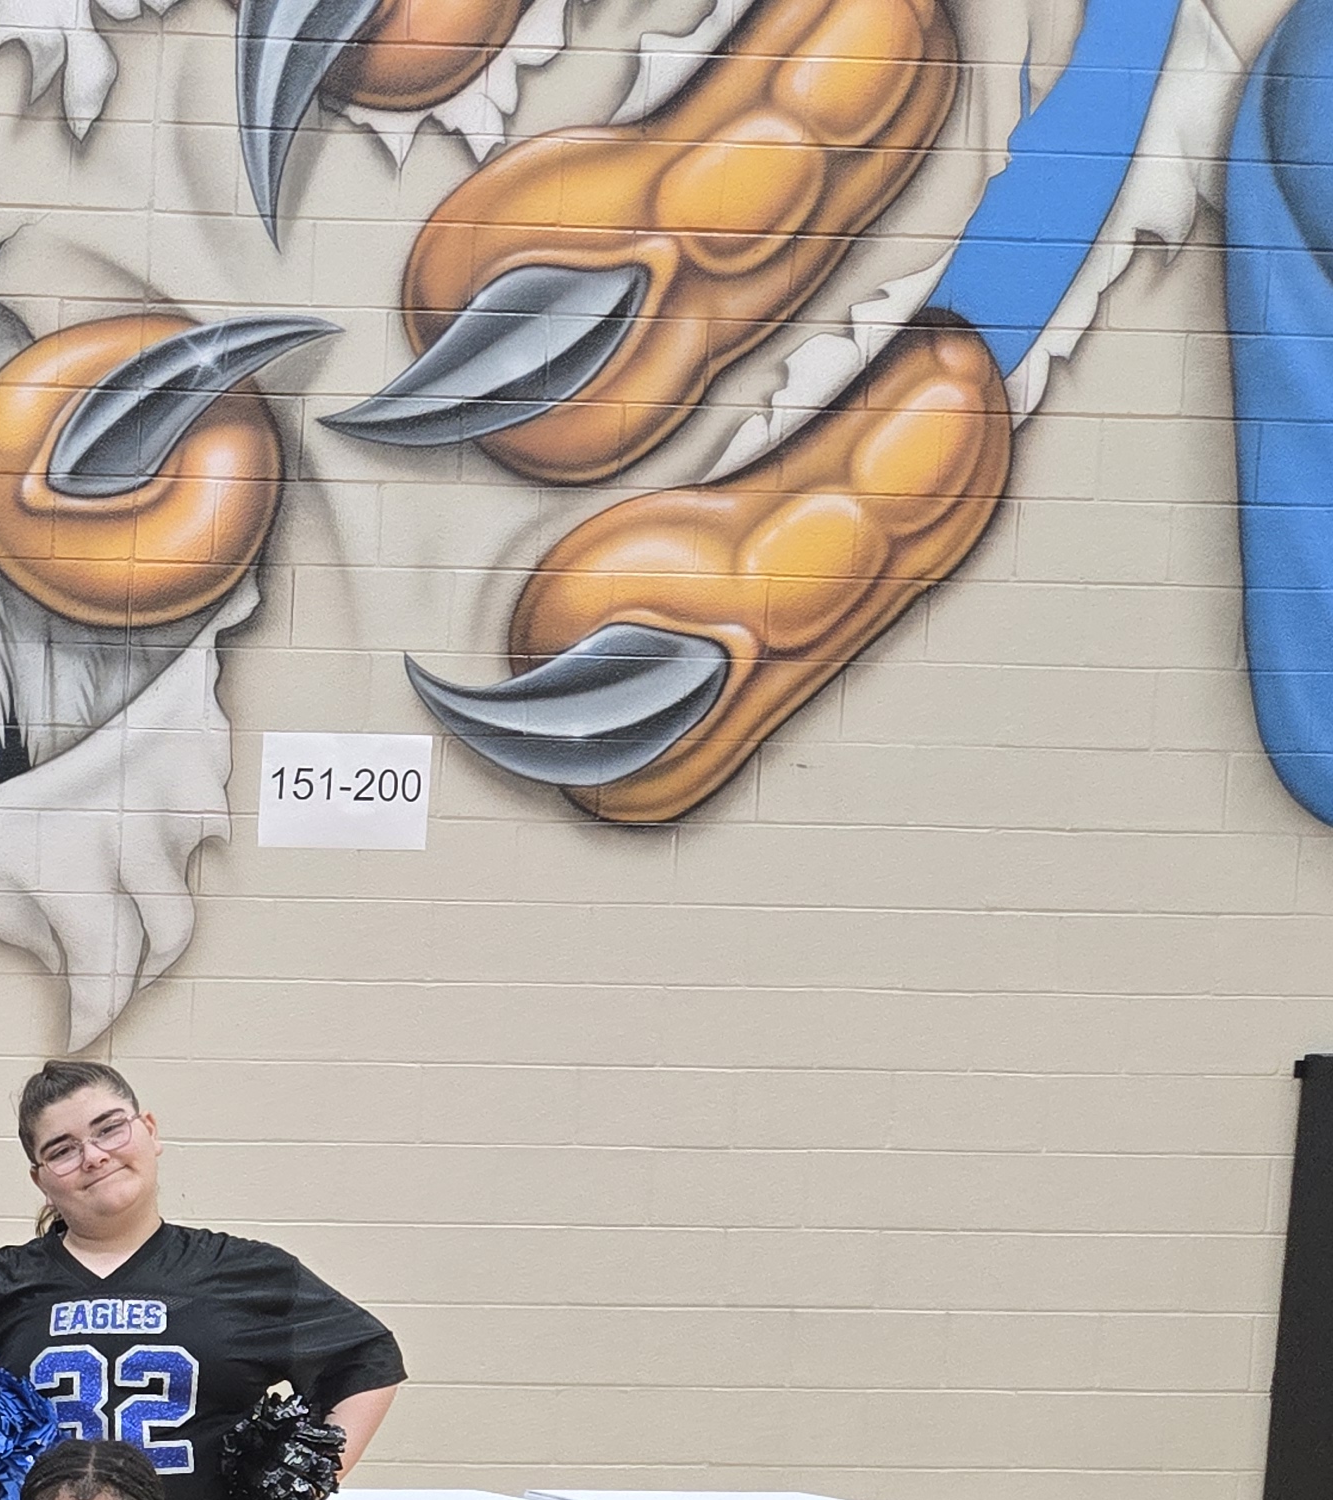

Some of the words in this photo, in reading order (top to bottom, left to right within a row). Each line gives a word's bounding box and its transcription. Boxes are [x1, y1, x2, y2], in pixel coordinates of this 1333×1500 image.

[271, 766, 421, 803] 151-200
[50, 1299, 167, 1336] EAGLES
[30, 1344, 199, 1475] 32
